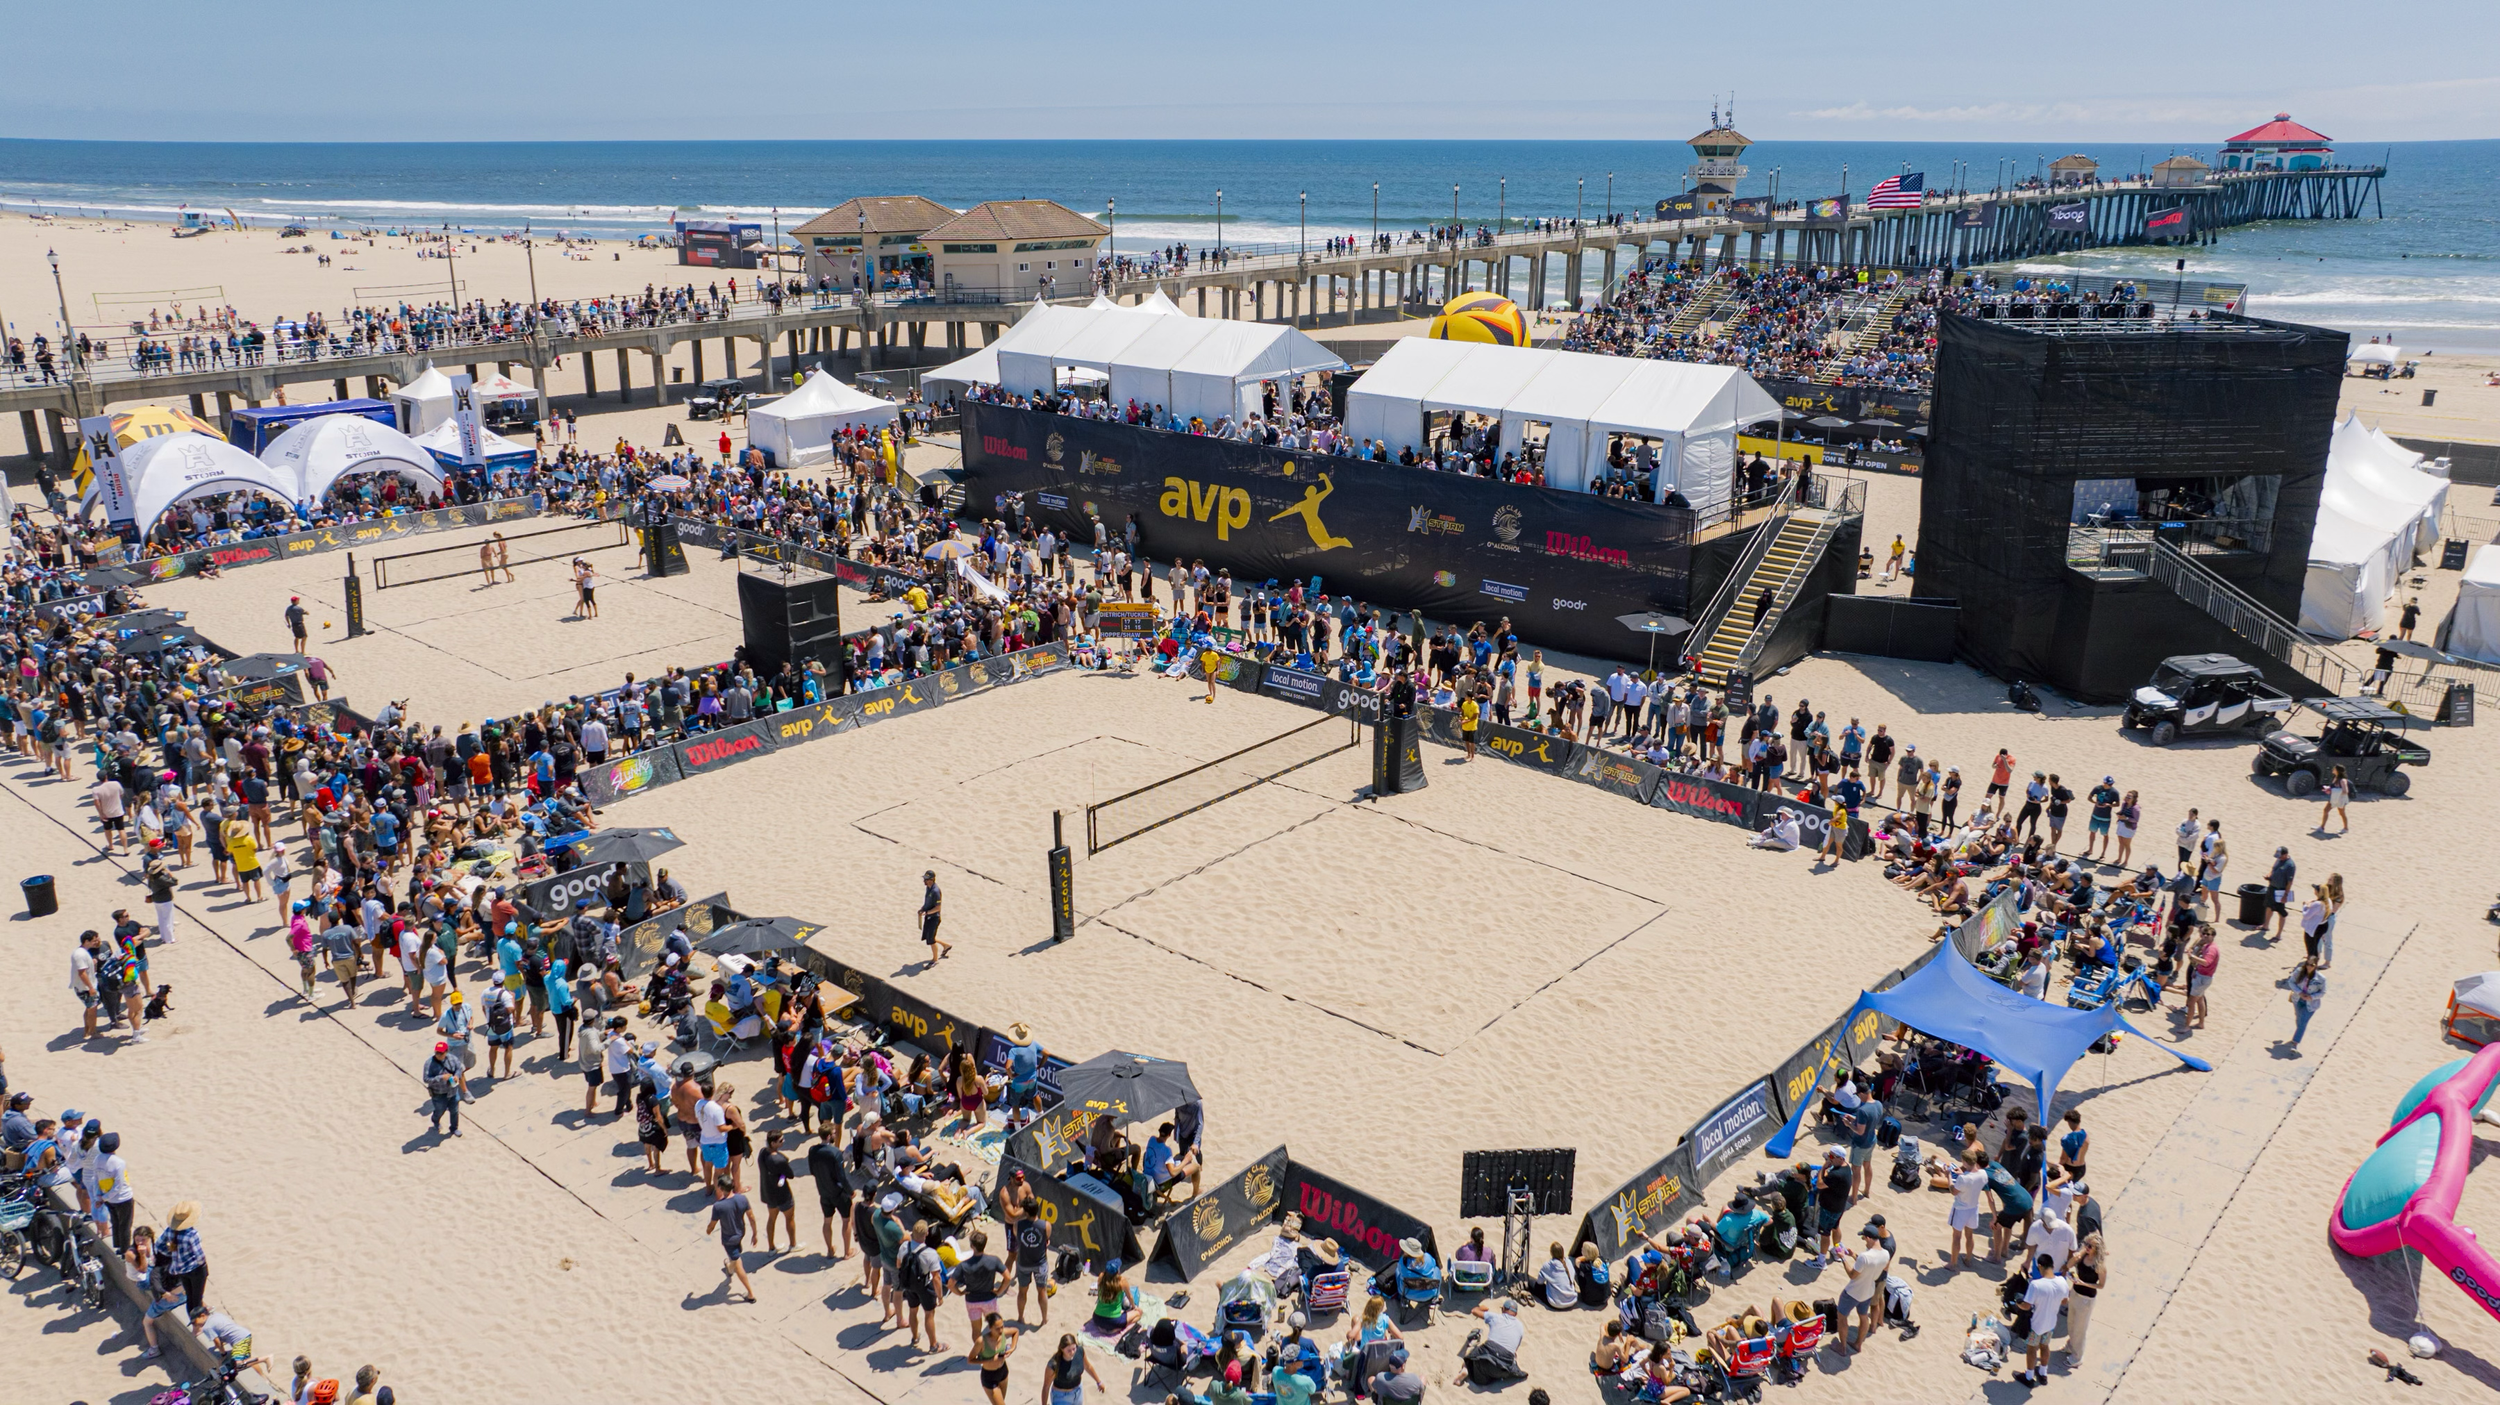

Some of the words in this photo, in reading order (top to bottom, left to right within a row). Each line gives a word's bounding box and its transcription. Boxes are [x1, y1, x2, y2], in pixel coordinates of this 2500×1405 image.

[1785, 396, 1813, 411] avp
[345, 450, 381, 459] STORM
[983, 435, 1028, 461] Wilson
[184, 470, 225, 481] STORM
[1865, 460, 1888, 470] OPEN
[1900, 463, 1920, 473] avp
[1160, 476, 1252, 542] avp
[1492, 506, 1505, 526] WHITE
[1506, 505, 1522, 518] CLAW
[356, 526, 382, 540] avp
[677, 521, 706, 537] goodr
[1428, 518, 1465, 535] STORM
[288, 538, 316, 552] avp
[1494, 543, 1521, 553] ALCOHOL
[1546, 530, 1629, 567] Wilson
[211, 547, 271, 566] Wilson
[836, 563, 868, 584] Wilson
[1485, 583, 1500, 594] local
[1553, 598, 1588, 611] goodr
[1272, 671, 1290, 686] local
[243, 687, 285, 704] STORM
[1338, 689, 1380, 711] good
[864, 697, 895, 716] avp
[780, 718, 813, 738] avp
[685, 735, 762, 767] Wilson
[1490, 736, 1524, 758] avp
[611, 756, 651, 795] SLUNKS
[1603, 765, 1642, 785] STORM
[1667, 780, 1744, 818] Wilson
[1060, 856, 1066, 864] 2
[550, 862, 619, 911] good
[1062, 880, 1070, 919] COURT
[891, 1005, 928, 1038] avp
[1853, 1011, 1878, 1045] avp
[1788, 1065, 1816, 1102] avp
[1086, 1099, 1110, 1110] avp
[1701, 1129, 1723, 1154] local
[1718, 1147, 1734, 1163] VODKA
[1734, 1134, 1752, 1150] SODAS
[1244, 1172, 1252, 1200] WHITE
[1251, 1163, 1269, 1174] CLAW
[1646, 1173, 1668, 1194] REIGN
[1638, 1175, 1682, 1215] STORM
[1035, 1196, 1058, 1226] vp
[1192, 1204, 1200, 1235] WHITE
[1199, 1196, 1219, 1207] CLAW
[1299, 1181, 1401, 1260] Wilson
[1208, 1233, 1233, 1258] ALCOHOL
[2450, 1265, 2500, 1314] good
